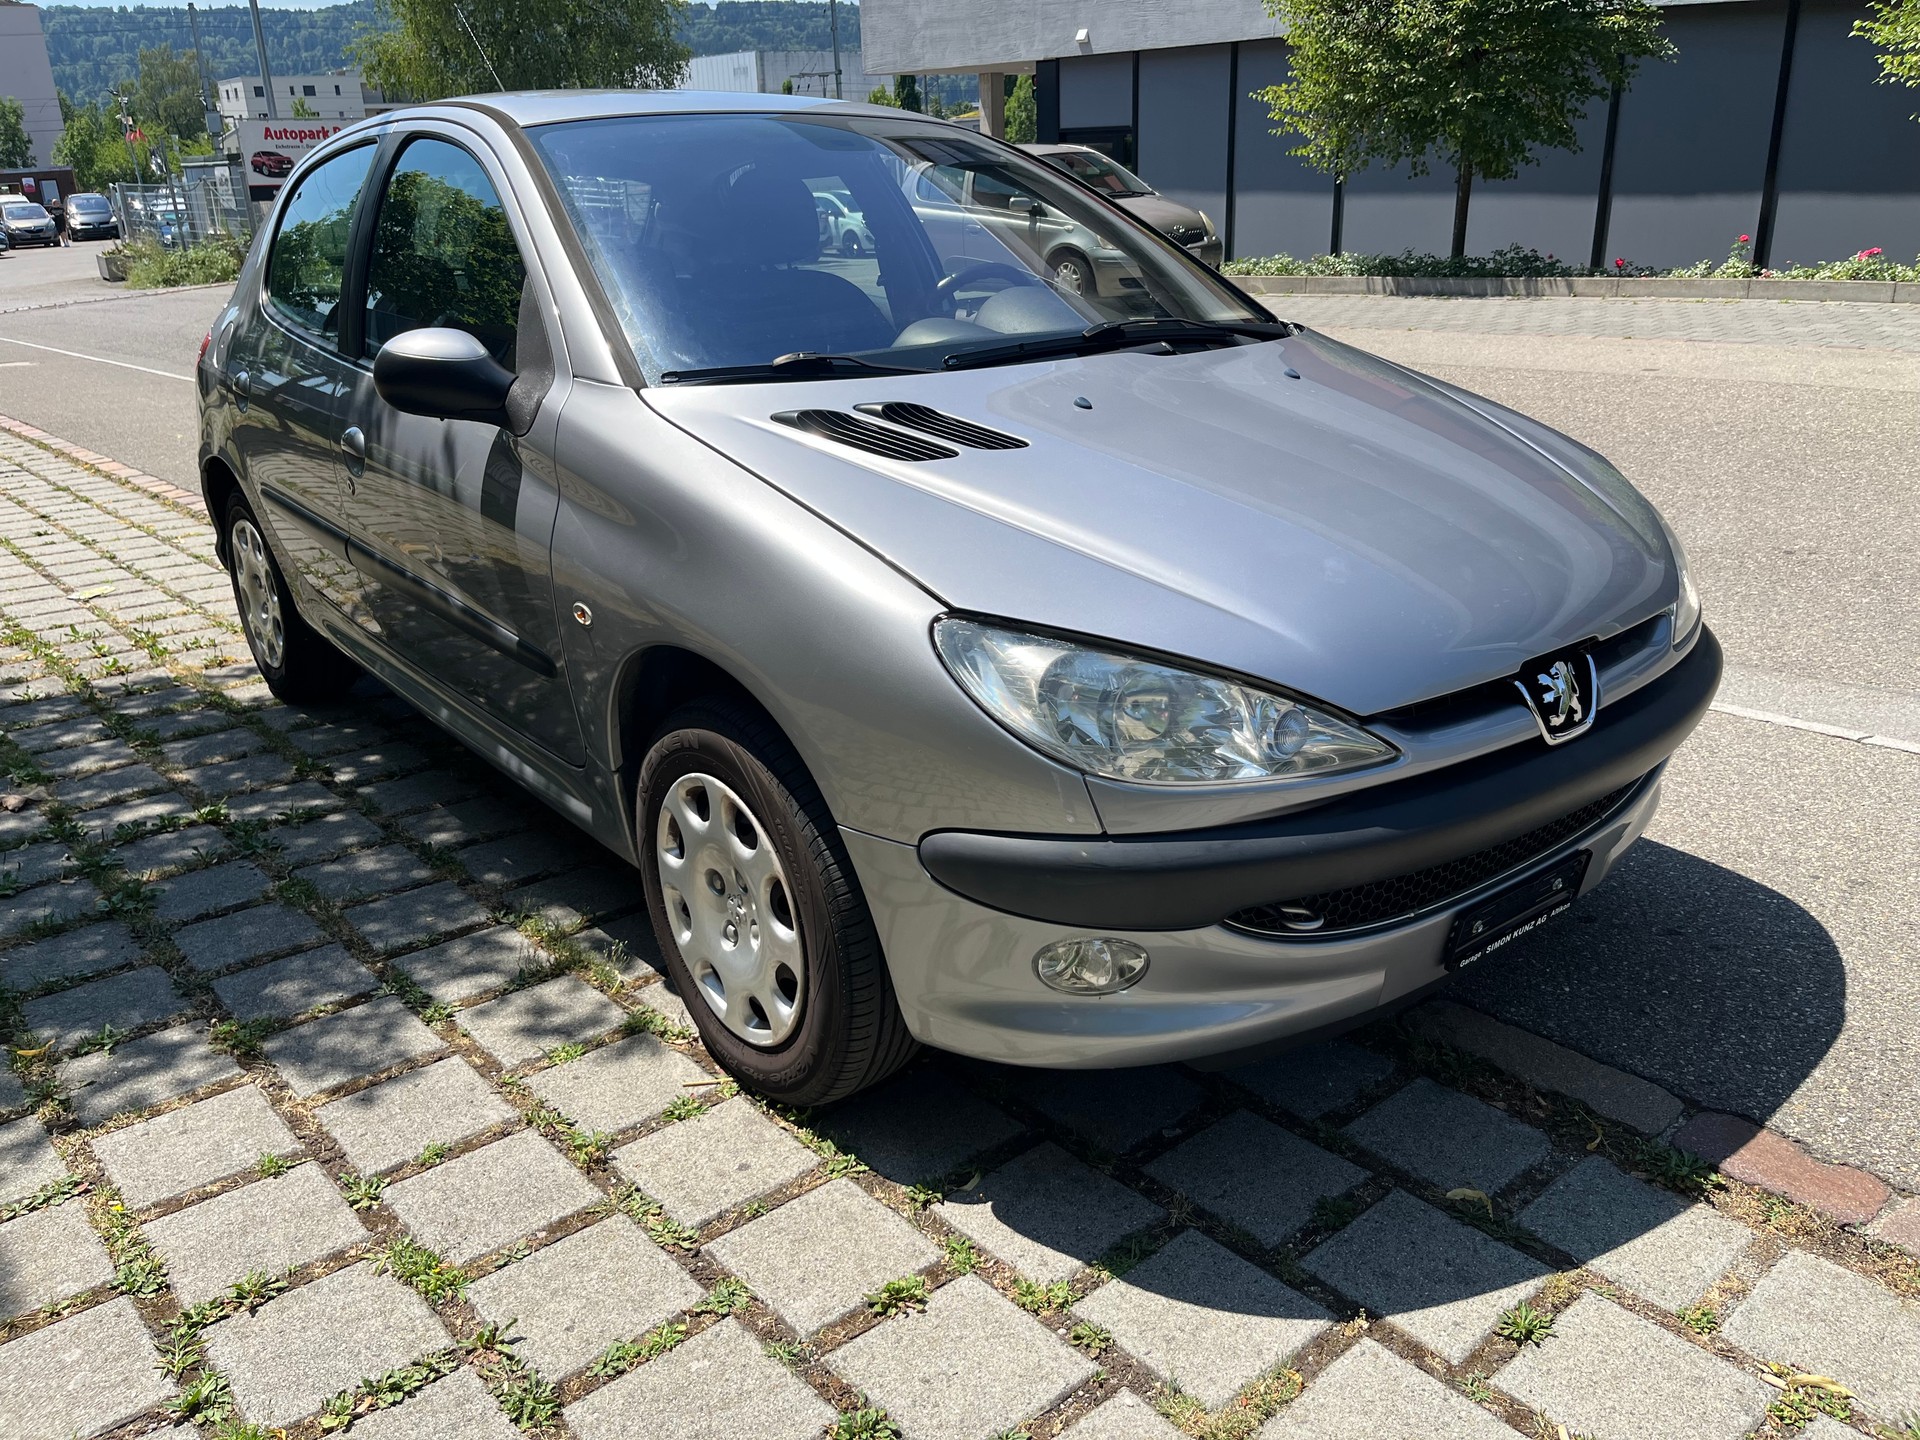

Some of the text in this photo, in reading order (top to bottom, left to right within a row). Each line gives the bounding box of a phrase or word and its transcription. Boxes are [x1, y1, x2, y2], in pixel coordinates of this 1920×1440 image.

[264, 126, 330, 143] Autopark
[1459, 951, 1482, 968] Garage
[1485, 934, 1512, 954] SIMON
[1512, 922, 1535, 939] KUNZ
[1535, 914, 1548, 927] AG
